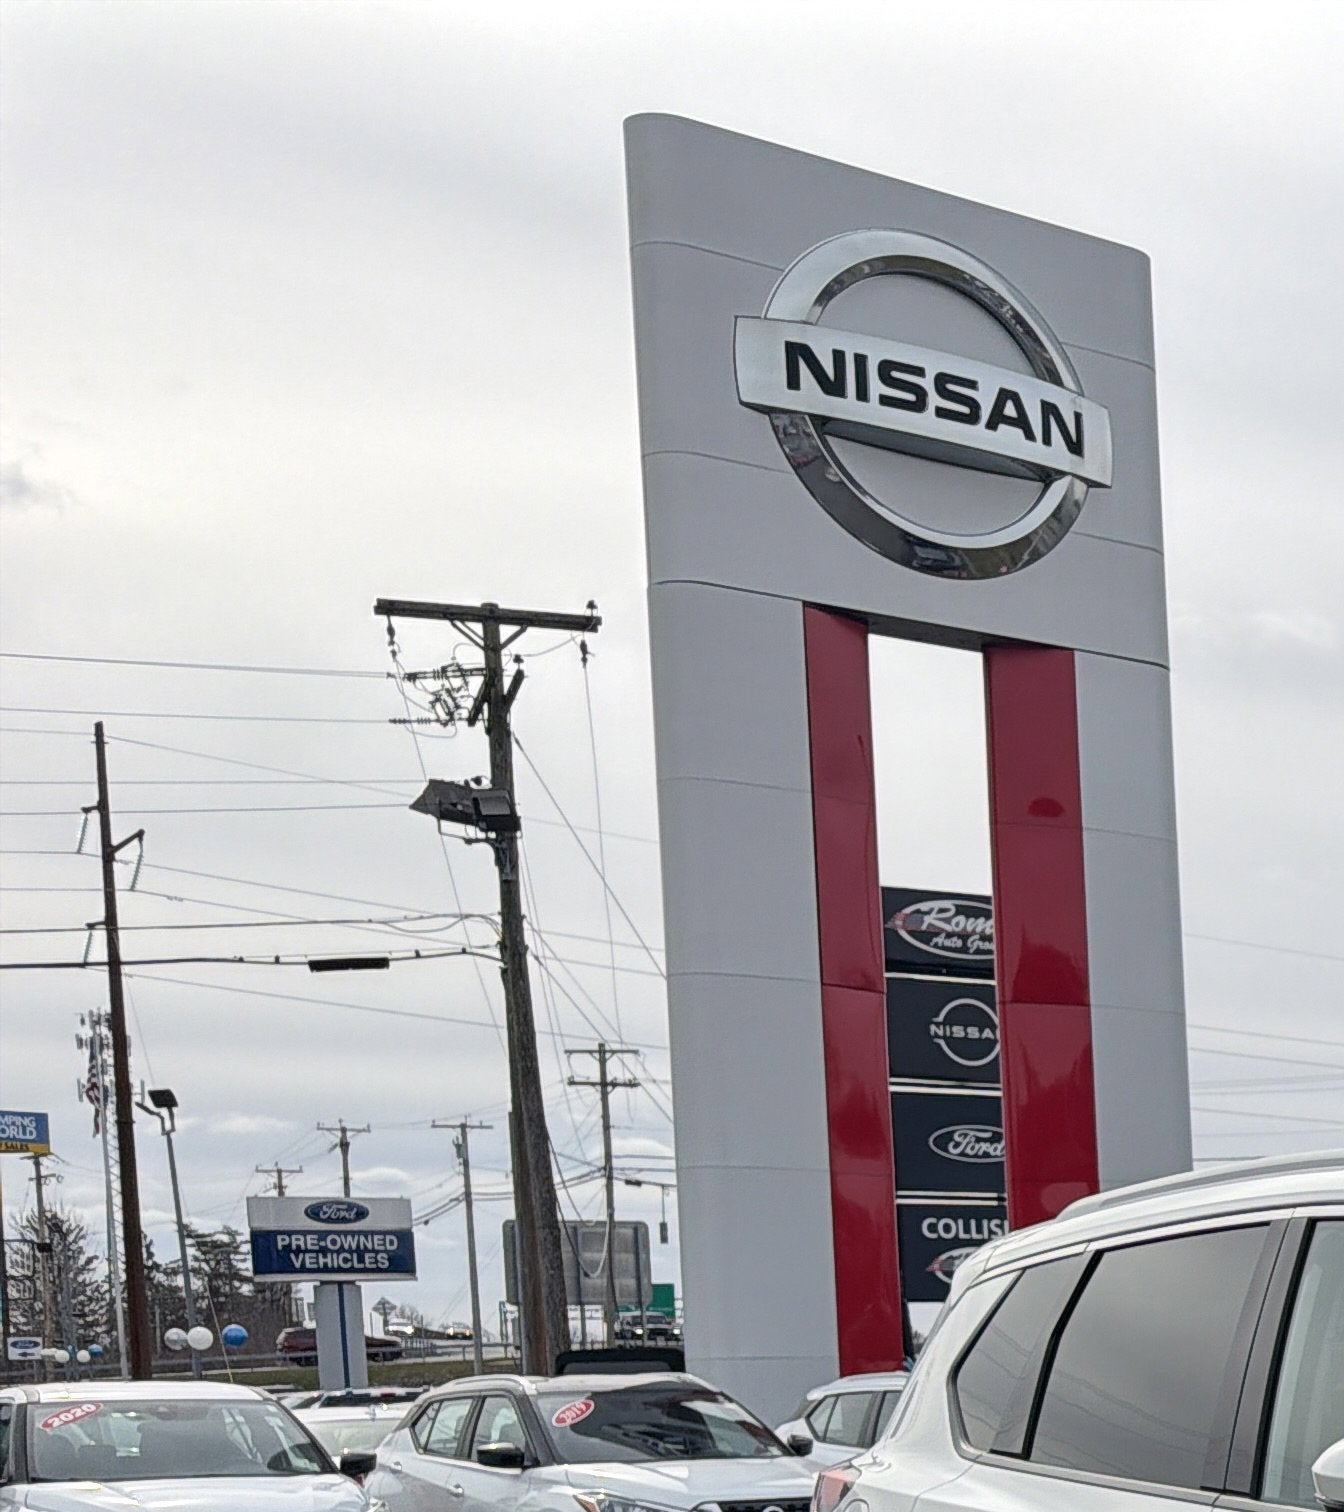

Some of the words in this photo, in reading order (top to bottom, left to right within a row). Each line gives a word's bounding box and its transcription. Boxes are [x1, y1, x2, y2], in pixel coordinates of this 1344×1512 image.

[784, 340, 1084, 458] NISSAN
[930, 931, 963, 948] Auto
[319, 1203, 358, 1220] Ford
[276, 1234, 398, 1250] PRE-OWNED
[290, 1252, 390, 1269] VEHICLES
[47, 1403, 97, 1428] 2020
